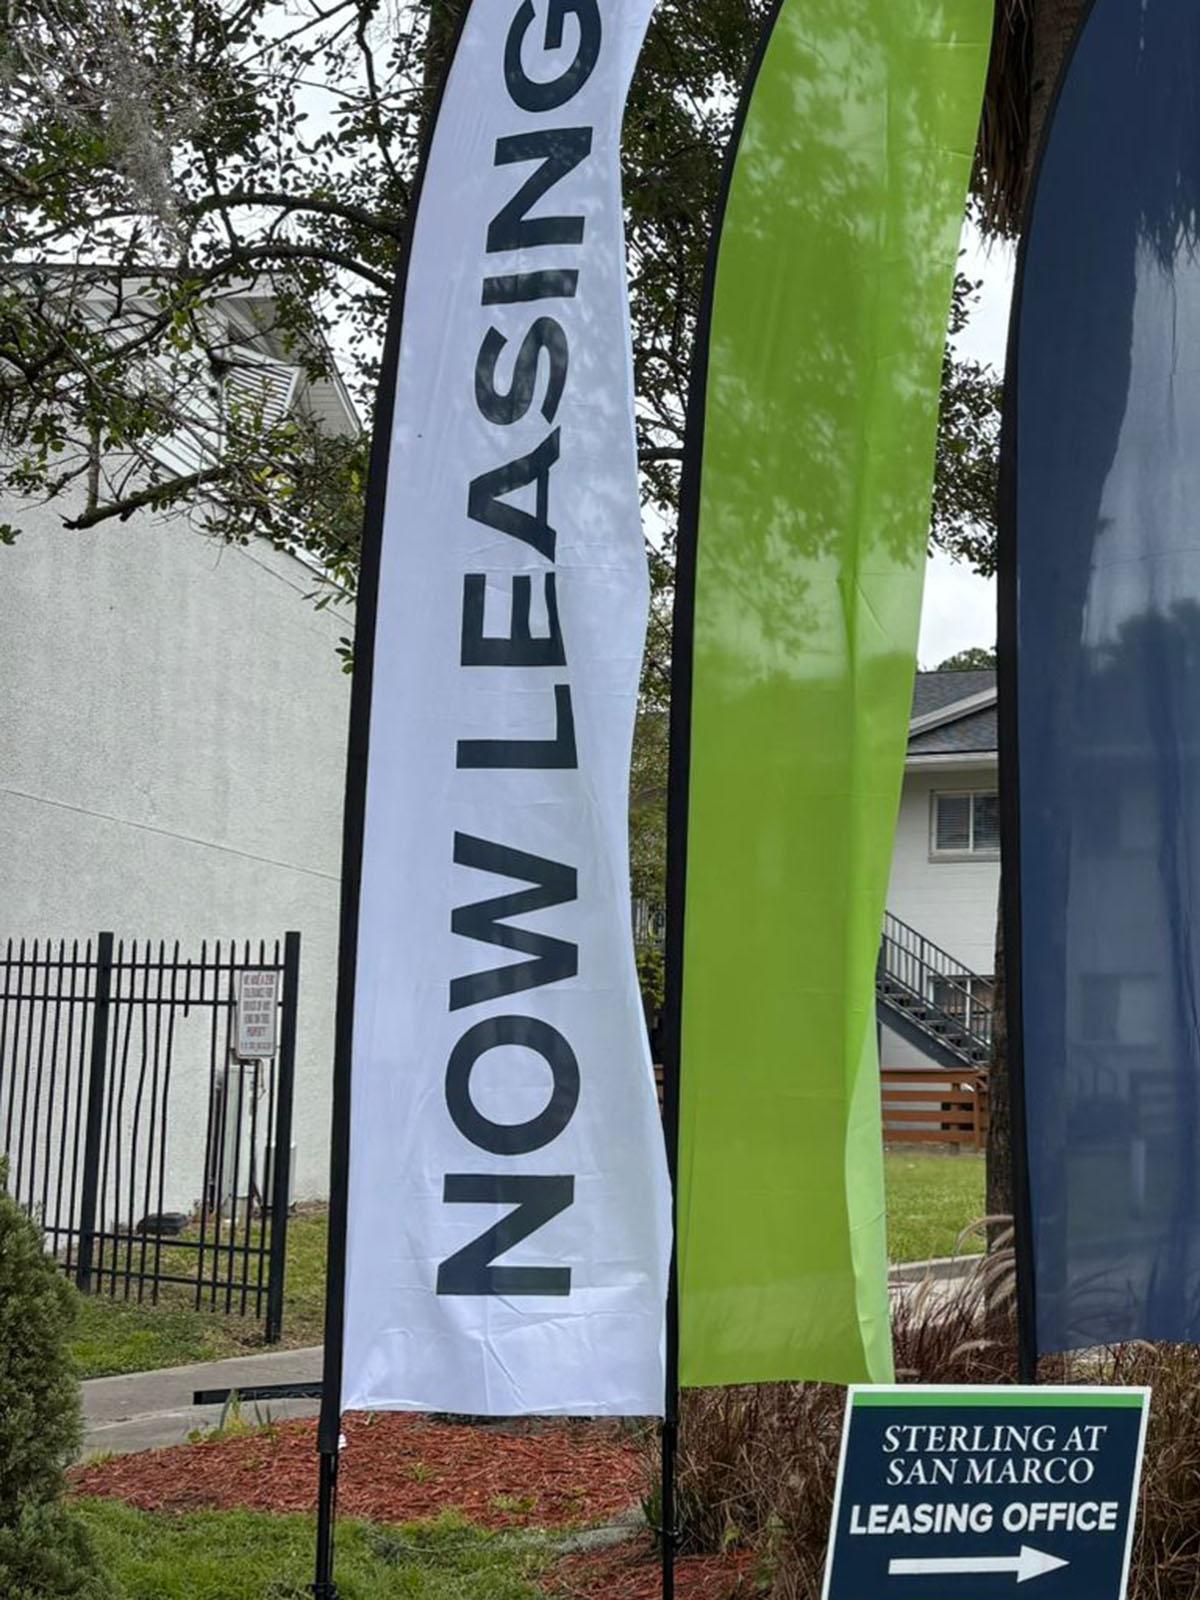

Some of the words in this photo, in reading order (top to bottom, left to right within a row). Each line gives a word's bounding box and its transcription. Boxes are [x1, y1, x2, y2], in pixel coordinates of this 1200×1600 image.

[456, 0, 602, 769] LEASING
[436, 830, 581, 1297] NOW
[882, 1424, 1057, 1453] STERLING
[1060, 1424, 1108, 1452] AT
[886, 1457, 958, 1486] SAN
[963, 1457, 1095, 1485] MARCO
[849, 1502, 994, 1535] LEASING
[1002, 1501, 1119, 1532] OFFICE
